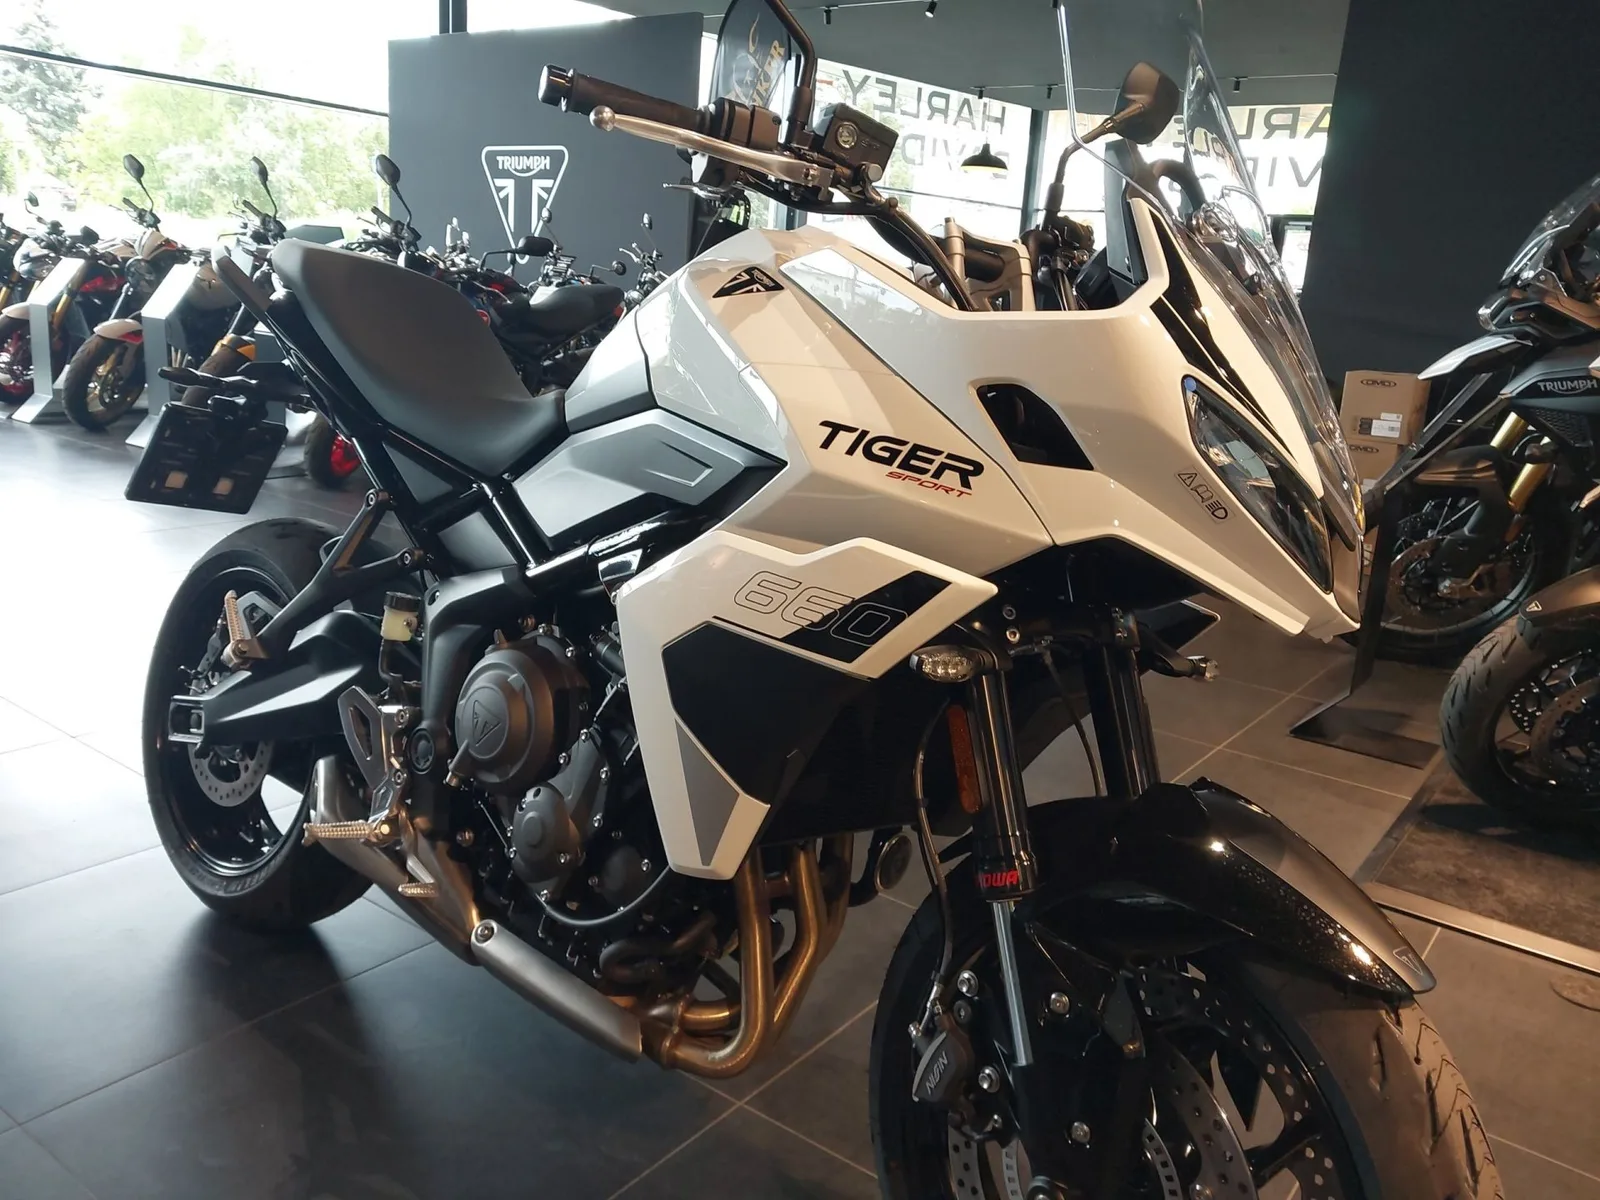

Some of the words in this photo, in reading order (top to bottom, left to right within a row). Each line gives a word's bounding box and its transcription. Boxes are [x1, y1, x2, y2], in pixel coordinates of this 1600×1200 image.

[495, 155, 551, 174] TRIUMPH
[1537, 379, 1598, 393] TRIUMPH
[818, 420, 985, 491] TIGER
[885, 471, 973, 498] SPORT
[733, 570, 909, 647] 660
